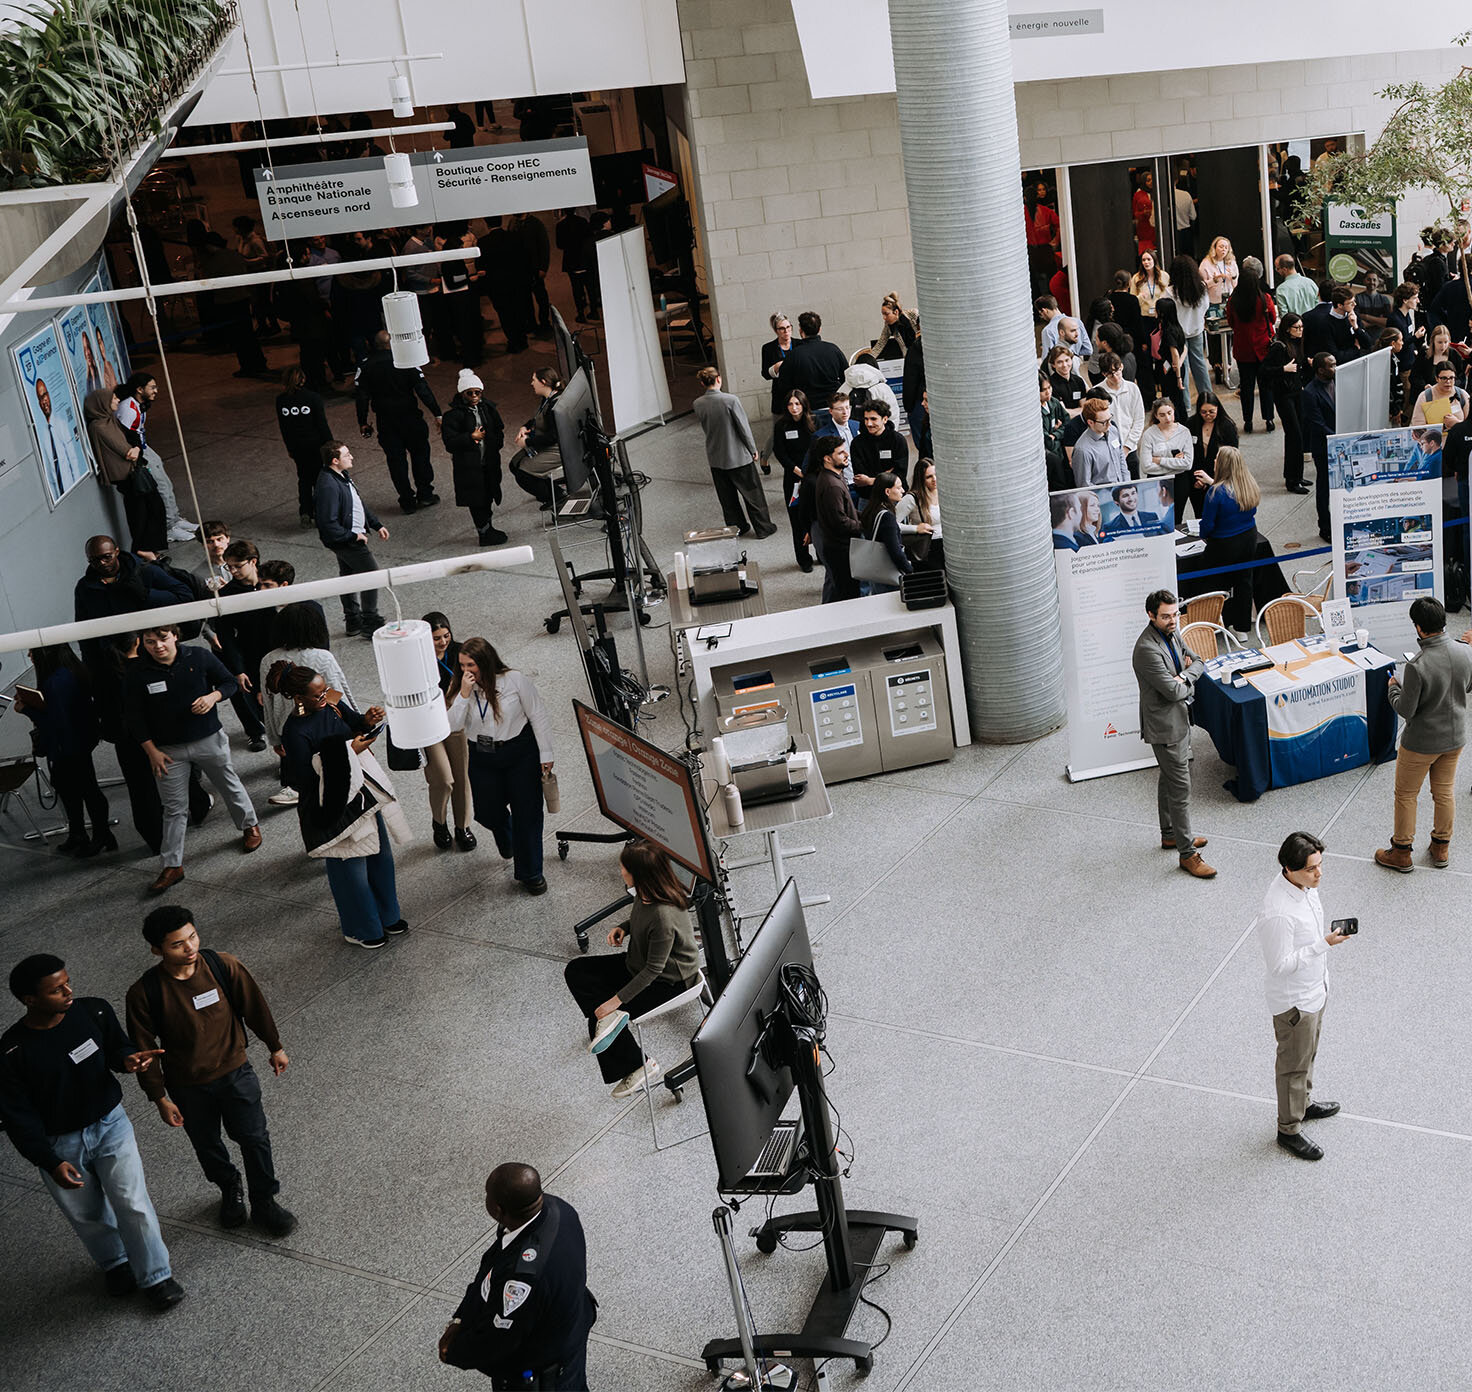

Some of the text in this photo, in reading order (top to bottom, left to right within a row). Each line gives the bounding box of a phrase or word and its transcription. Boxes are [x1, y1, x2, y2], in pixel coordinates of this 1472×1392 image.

[1016, 18, 1089, 31] énergie nouvelle
[436, 158, 541, 177] Boutique Coop HEC
[438, 176, 482, 189] Sécurité
[491, 167, 577, 184] Renseignements
[266, 180, 344, 196] Amphithéâtre
[268, 187, 372, 206] Banque Nationale
[271, 202, 371, 221] Ascenseurs nord
[1339, 220, 1381, 230] Cascades
[1343, 500, 1367, 508] logicielles
[1343, 513, 1372, 521] industrielle
[1110, 548, 1125, 556] notre
[1125, 546, 1145, 555] équipe
[1071, 561, 1085, 570] pour
[1097, 556, 1118, 565] carrière
[1119, 553, 1149, 562] stimulante
[1290, 675, 1356, 704] AUTOMATION STUDIO
[584, 713, 601, 731] Zone
[602, 728, 628, 747] orange
[631, 742, 660, 766] Orange
[659, 758, 679, 778] Zone
